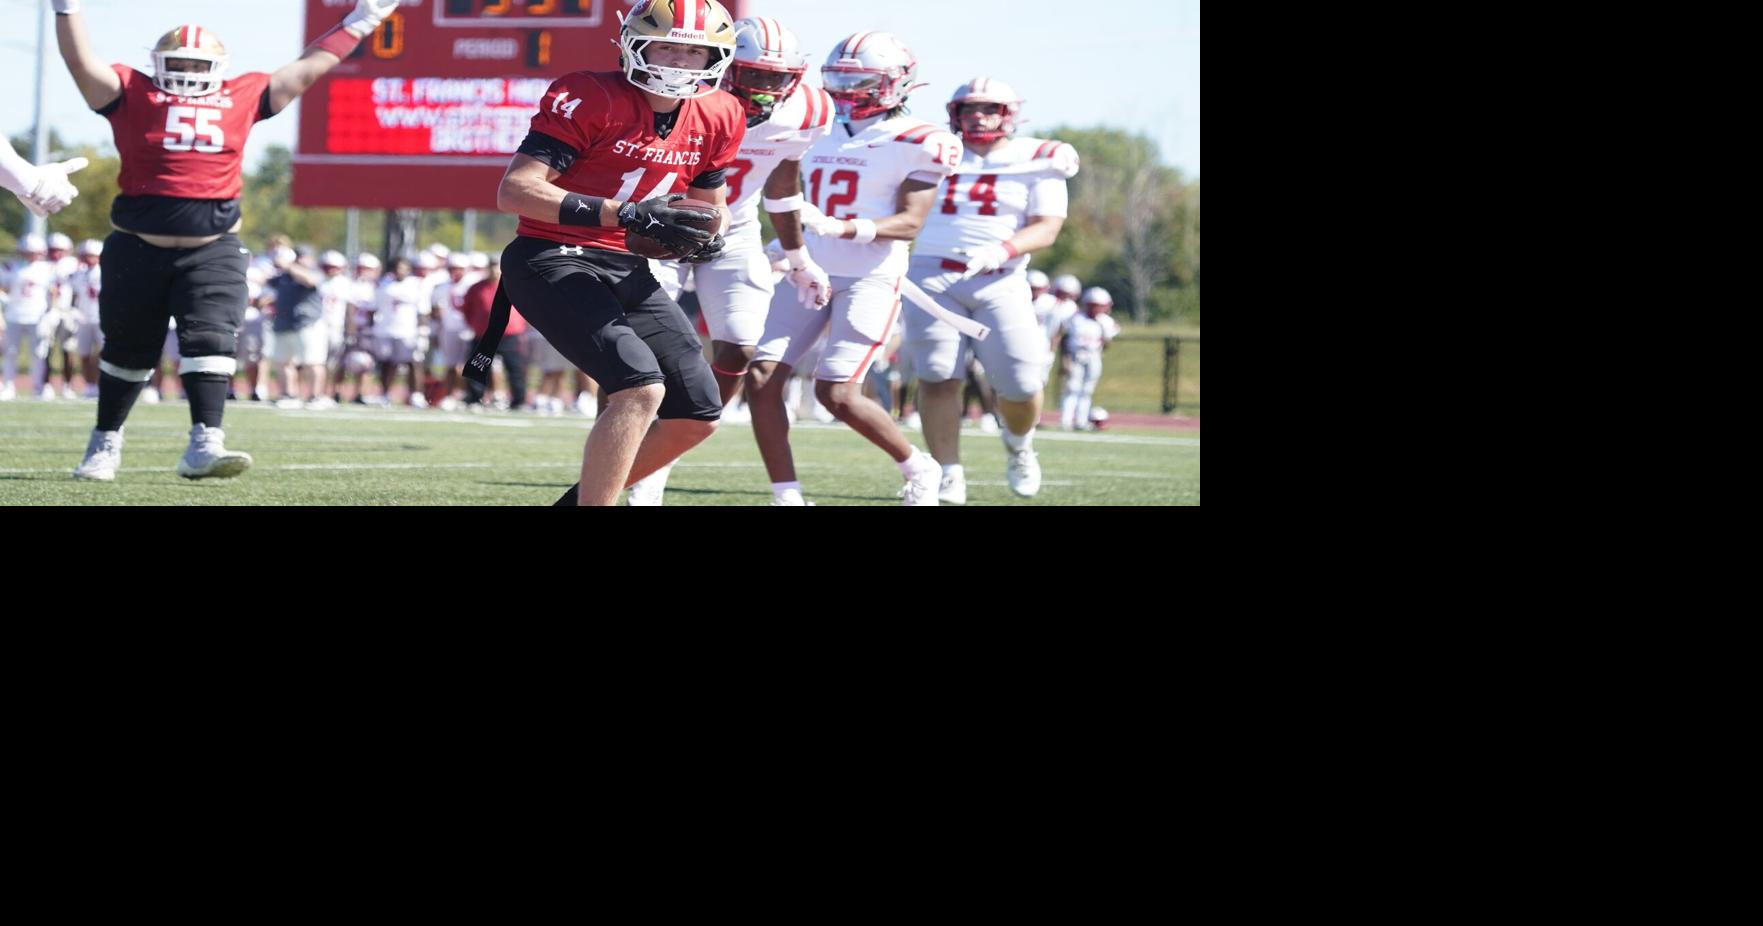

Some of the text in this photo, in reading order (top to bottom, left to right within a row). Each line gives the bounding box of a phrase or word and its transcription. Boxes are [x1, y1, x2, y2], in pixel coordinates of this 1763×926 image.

[372, 10, 404, 58] 0
[671, 31, 705, 40] Riddell
[551, 91, 583, 119] 14
[163, 105, 225, 153] 55
[612, 139, 702, 166] ST. FRANCIS
[931, 142, 960, 167] 12
[809, 168, 860, 222] 12
[940, 172, 999, 217] 14
